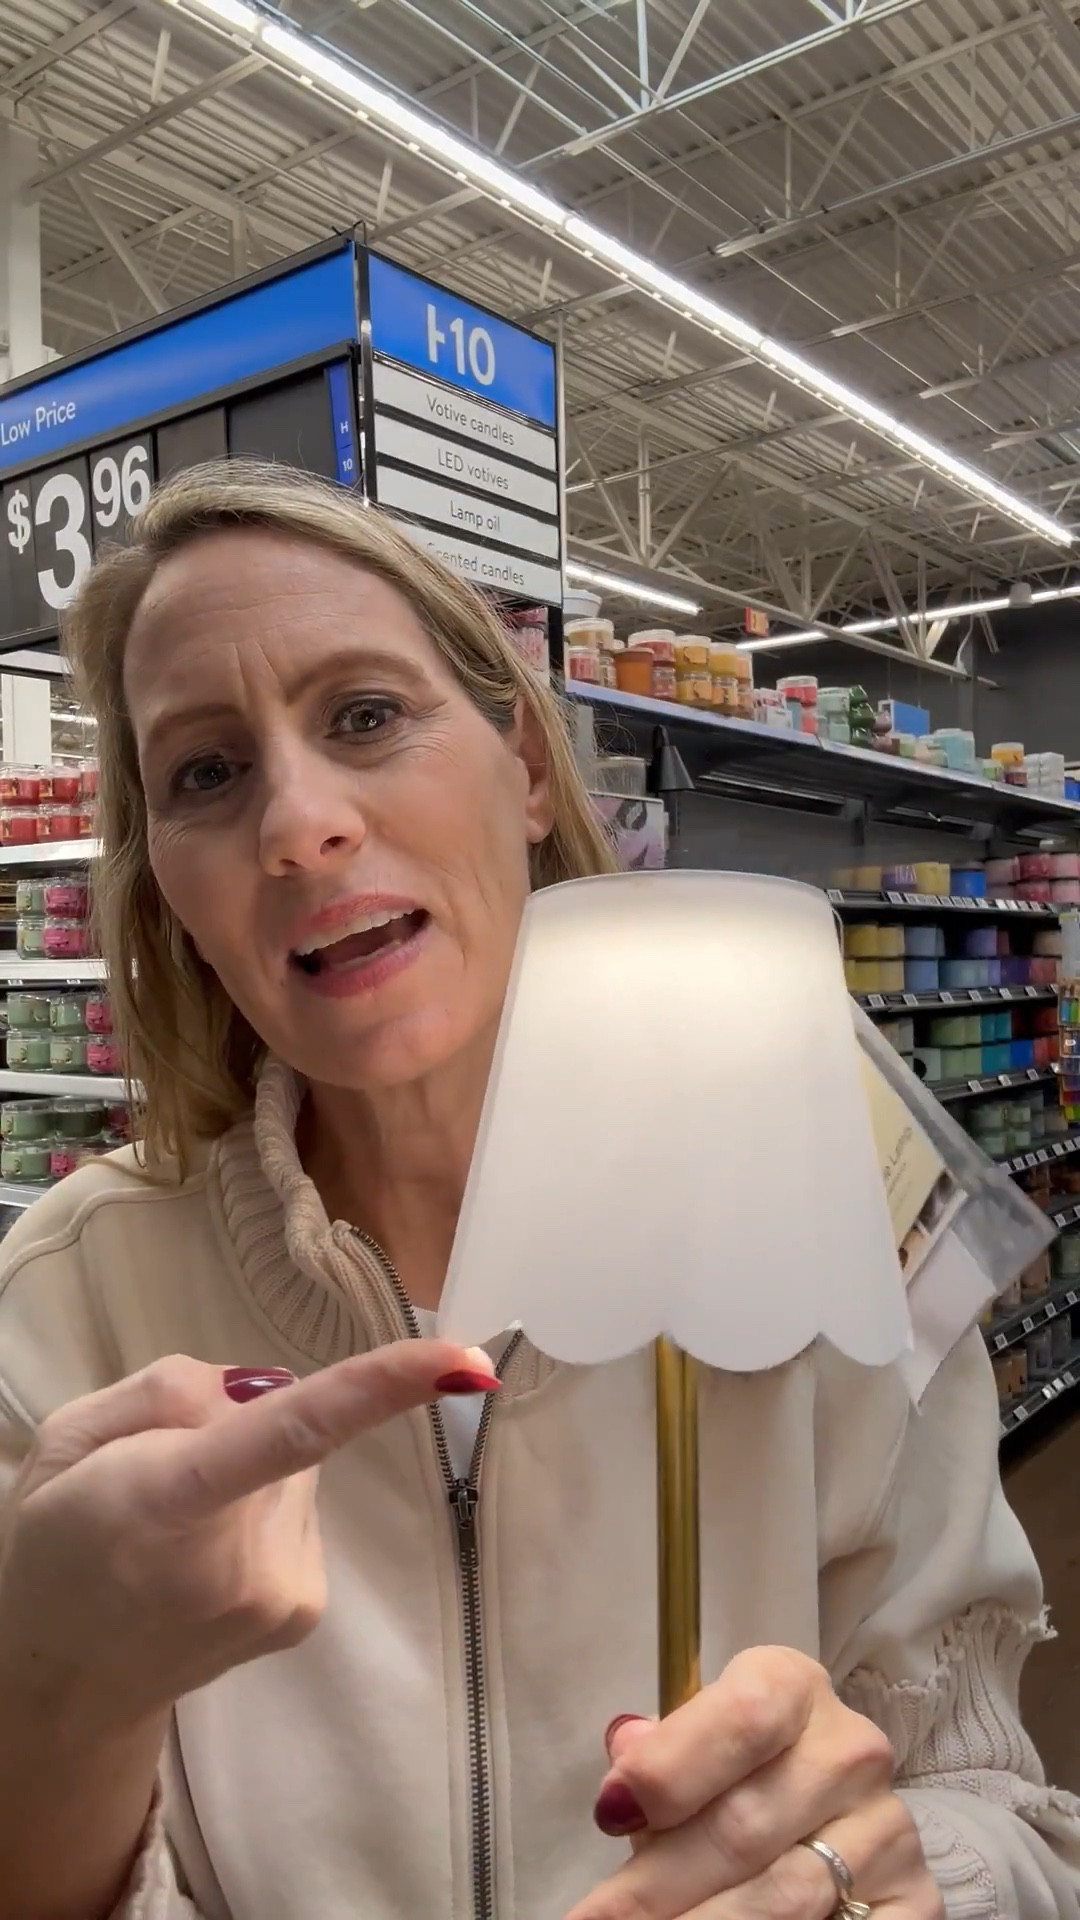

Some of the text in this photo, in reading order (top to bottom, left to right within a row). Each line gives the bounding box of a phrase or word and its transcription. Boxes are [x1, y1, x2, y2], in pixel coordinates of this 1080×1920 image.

[0, 401, 76, 446] Low Price
[340, 421, 349, 434] H
[427, 394, 515, 446] Votive candles
[342, 458, 353, 472] 10
[437, 448, 509, 490] LED votives
[450, 499, 501, 533] Lamp oil
[427, 541, 525, 586] ented candles
